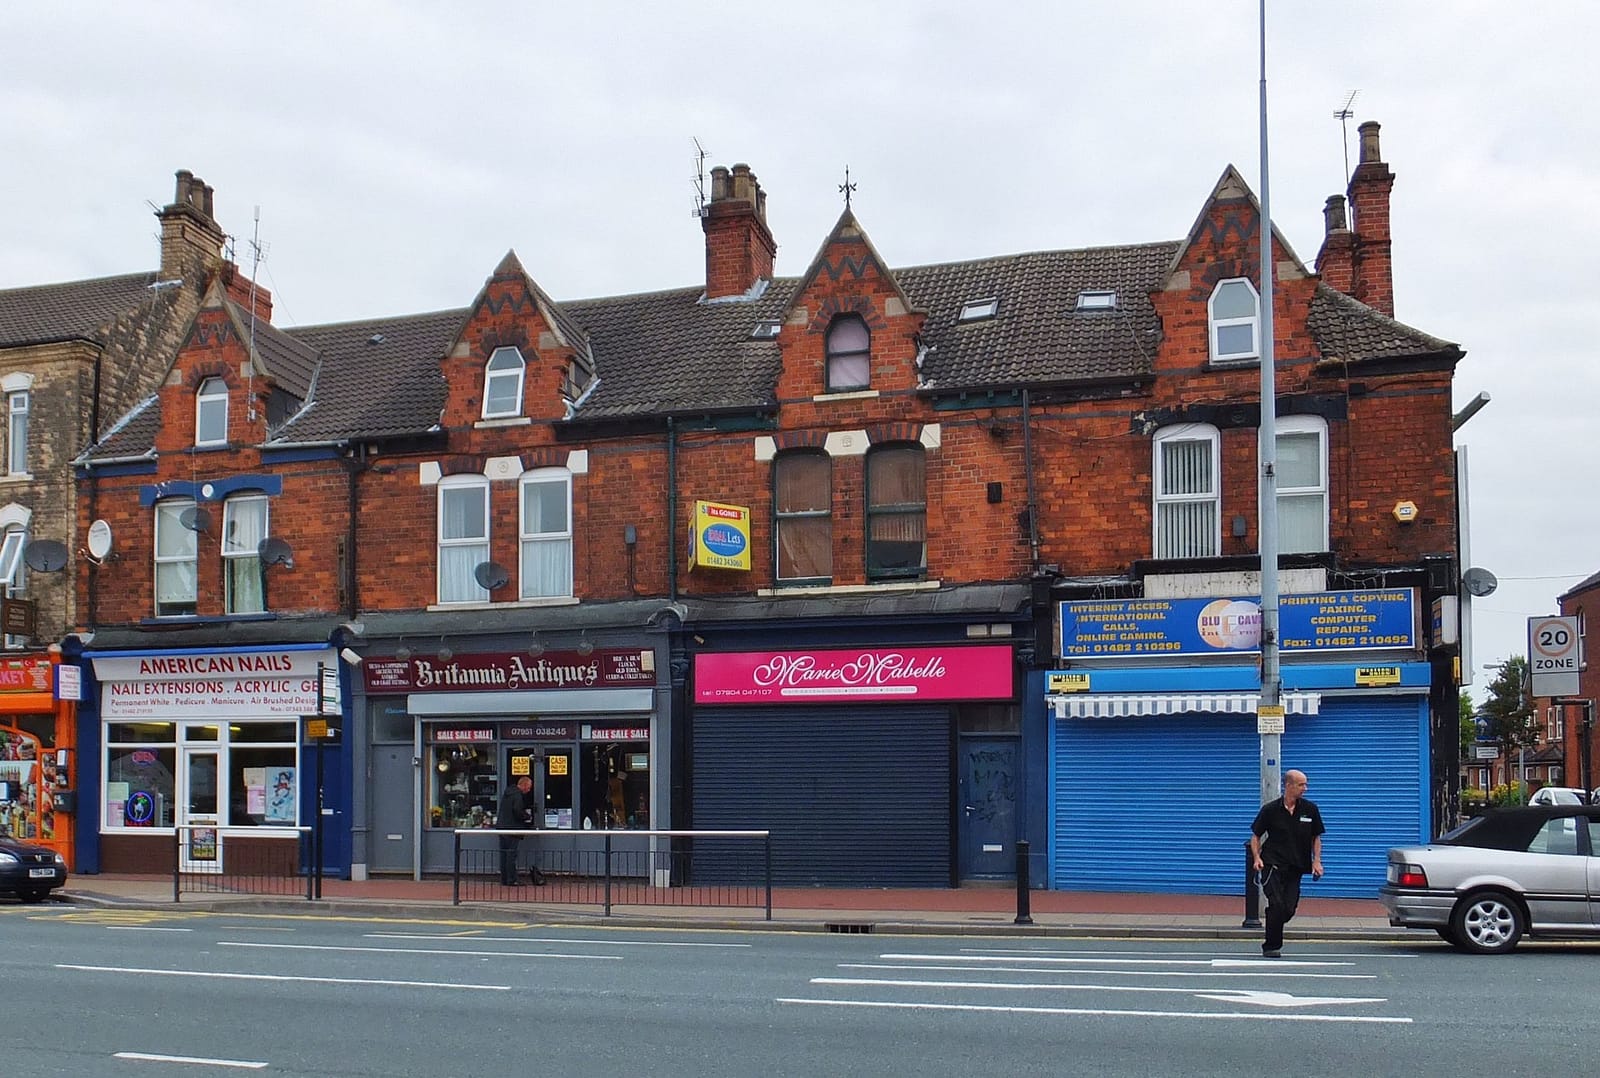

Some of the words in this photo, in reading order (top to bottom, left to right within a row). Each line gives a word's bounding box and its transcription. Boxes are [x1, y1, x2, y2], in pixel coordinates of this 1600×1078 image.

[1280, 596, 1337, 605] PRINTING
[1352, 594, 1407, 602] COPYING,
[1070, 604, 1124, 613] INTERNET
[1128, 602, 1173, 612] ACCESS,
[1320, 605, 1367, 614] FAXING,
[1077, 613, 1166, 622] INTERNATIONAL
[1311, 615, 1376, 624] COMPUTER
[1103, 623, 1139, 631] CALLS,
[1283, 639, 1312, 647] Fax:
[1315, 637, 1355, 646] 01482
[1359, 635, 1408, 644] 210492
[1540, 630, 1568, 646] 20
[1094, 643, 1132, 653] 01482
[140, 656, 234, 674] AMERICAN
[237, 654, 292, 672] NAILS
[1536, 658, 1568, 669] ZONE
[415, 660, 506, 687] Britannia
[508, 656, 600, 689] Antiques
[753, 655, 842, 686] Marie
[840, 653, 946, 684] Mabelle
[0, 669, 26, 685] KET
[111, 683, 141, 696] NAIL
[144, 681, 224, 695] EXTENSIONS
[234, 681, 290, 693] ACRYLIC
[301, 680, 319, 692] GE
[111, 698, 149, 706] Permanent
[175, 697, 206, 705] Pedicure
[263, 696, 293, 704] Brushed
[295, 696, 317, 705] Desig
[437, 730, 454, 740] SALE
[455, 730, 472, 739] SALE
[473, 730, 490, 739] SALE
[592, 730, 609, 739] SALE
[610, 730, 628, 739] SALE
[630, 729, 649, 739] SALE
